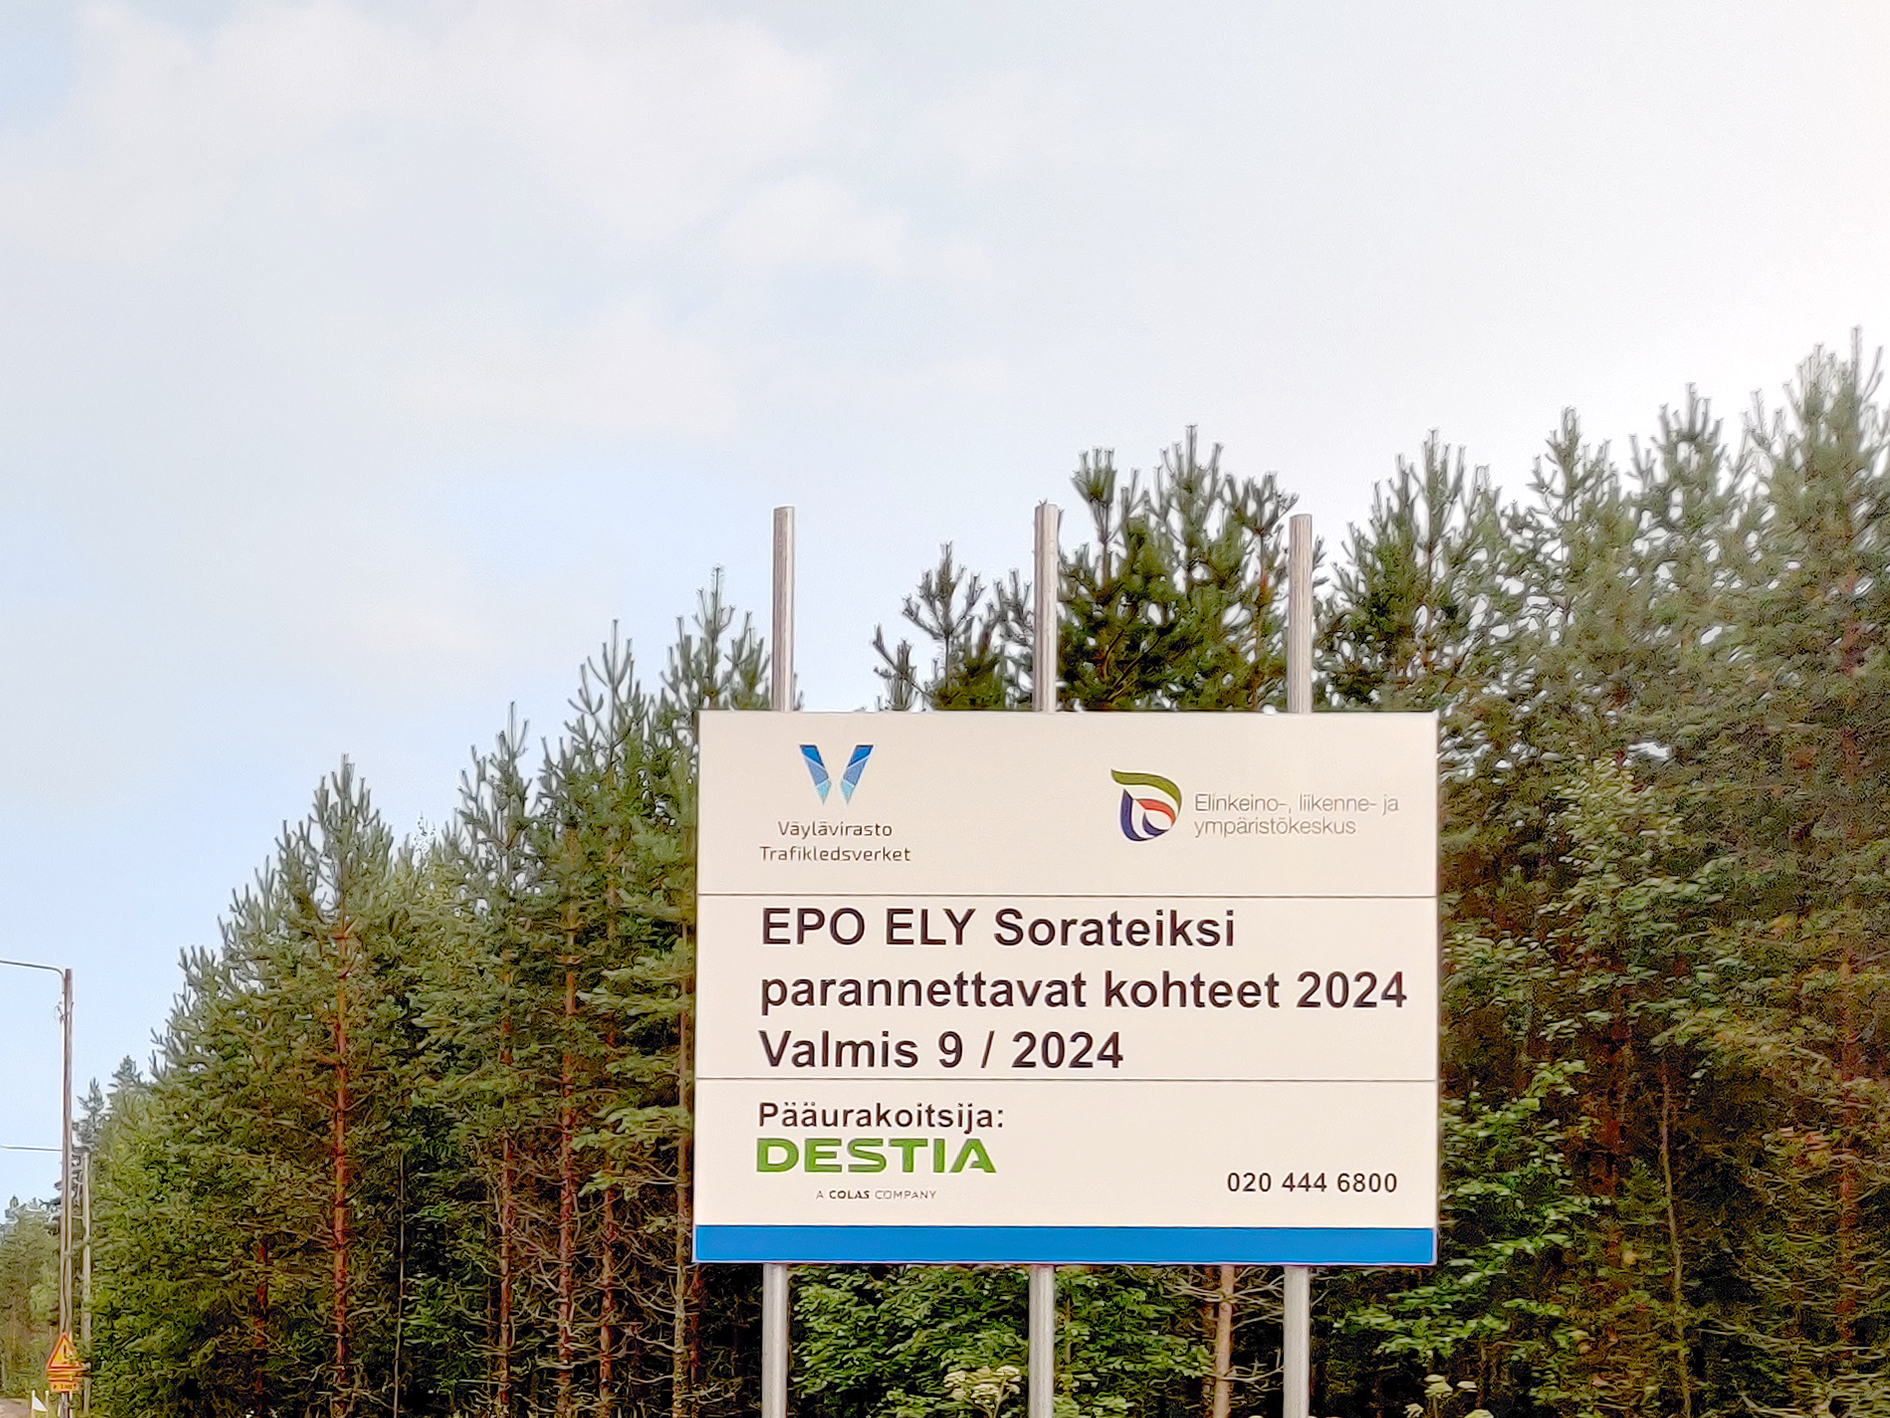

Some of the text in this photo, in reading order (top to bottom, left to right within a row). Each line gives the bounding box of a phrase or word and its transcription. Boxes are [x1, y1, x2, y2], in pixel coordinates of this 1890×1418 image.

[1194, 793, 1400, 816] Elinkeino-, liikenne- ja
[777, 819, 893, 839] Väylävirasto
[1193, 816, 1358, 838] ympäristökeskus
[758, 845, 912, 862] Trafikledsverket
[761, 907, 1234, 947] EPO ELY Sorateiksi
[761, 969, 1408, 1017] parannettavat kohteet 2024
[757, 1029, 1124, 1069] Valmis 9 / 2024
[758, 1101, 1004, 1135] Pääurakoitsija:
[756, 1137, 997, 1174] DESTIA
[1226, 1171, 1398, 1194] 020 444 6800
[815, 1189, 937, 1200] A COLAS COMPANY
